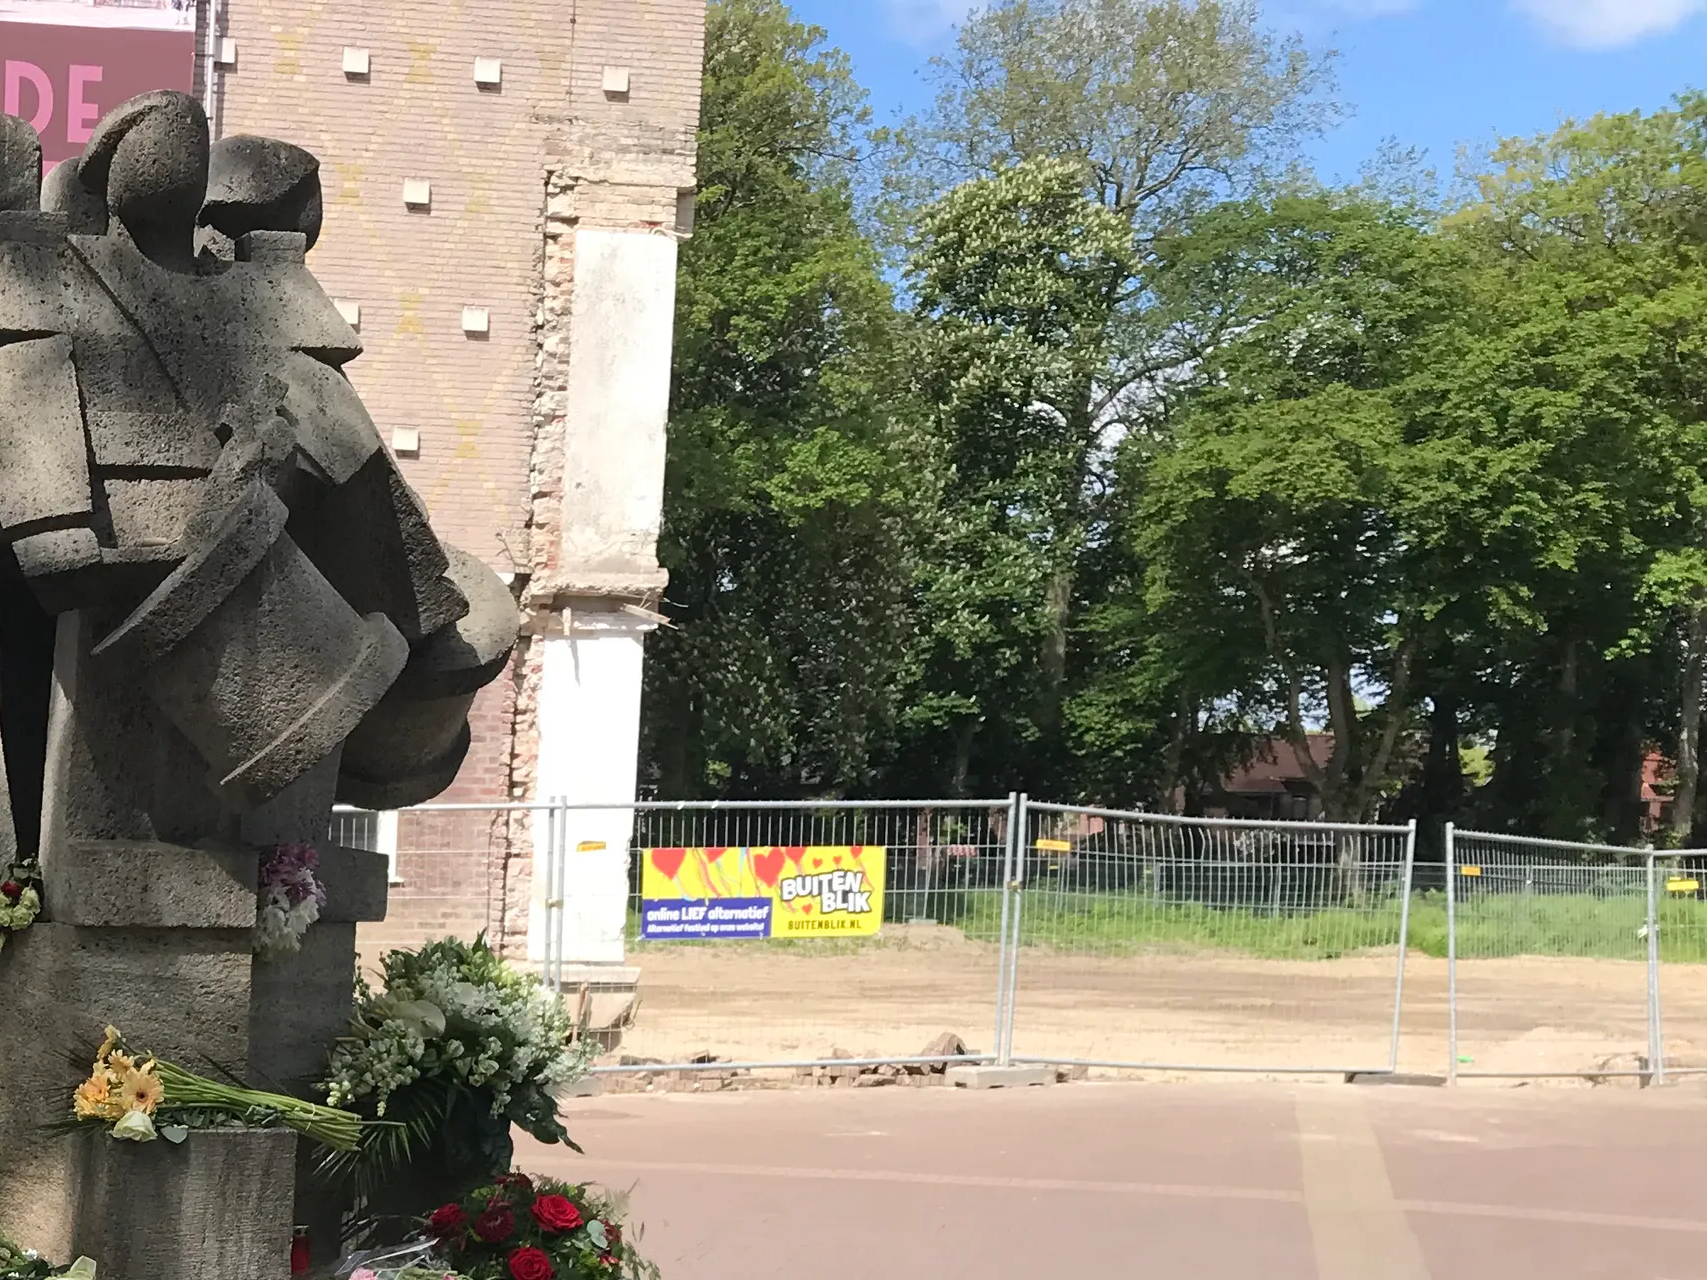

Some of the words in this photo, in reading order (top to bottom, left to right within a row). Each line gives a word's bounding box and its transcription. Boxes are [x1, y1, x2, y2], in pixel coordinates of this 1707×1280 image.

[781, 869, 863, 901] BUITEN
[647, 907, 680, 921] online
[681, 907, 707, 920] LIEF
[708, 906, 769, 920] alternatief
[821, 890, 872, 914] BLIK
